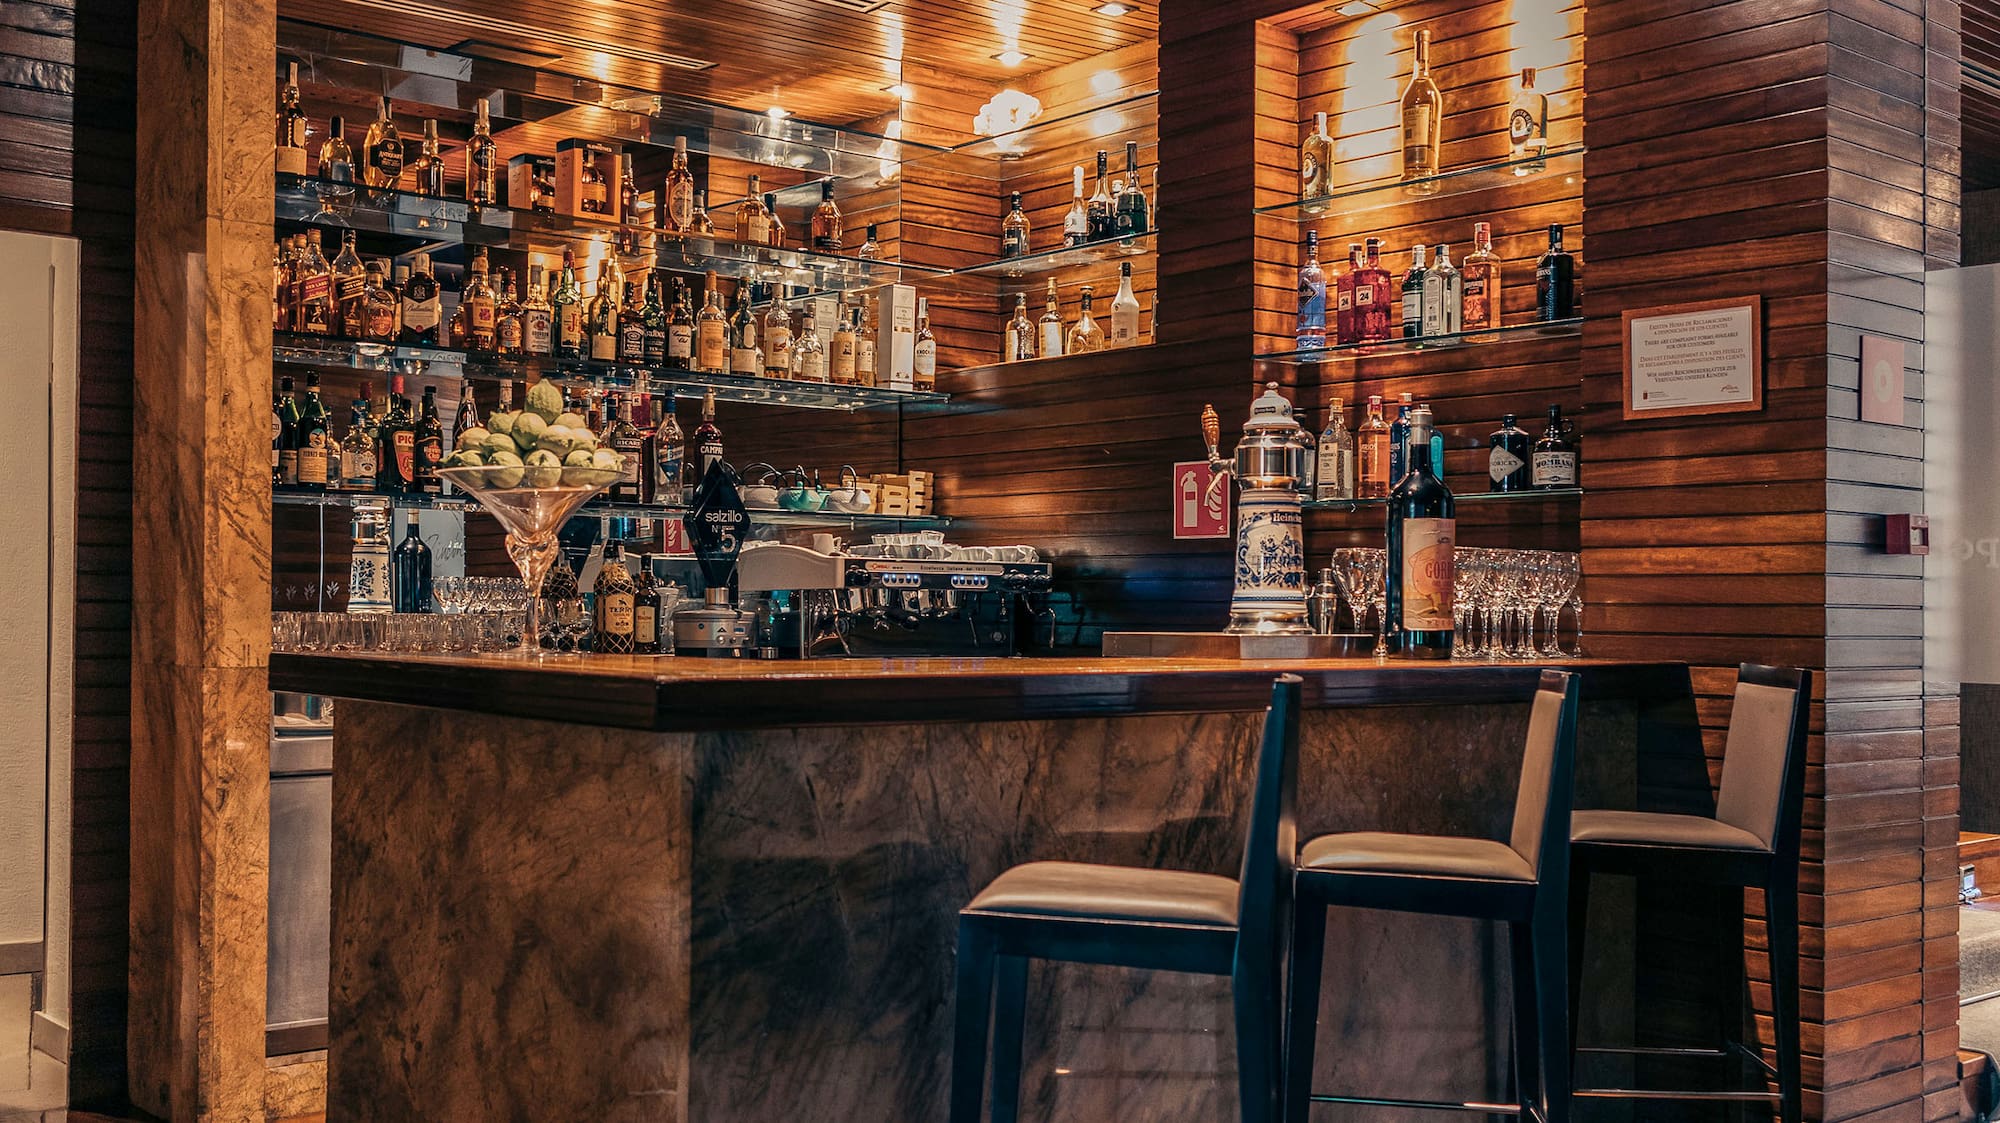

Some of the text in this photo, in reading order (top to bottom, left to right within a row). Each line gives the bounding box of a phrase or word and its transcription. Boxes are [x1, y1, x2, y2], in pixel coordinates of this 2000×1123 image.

[1359, 292, 1368, 301] 24
[705, 509, 742, 522] salzillo
[721, 526, 736, 553] 5
